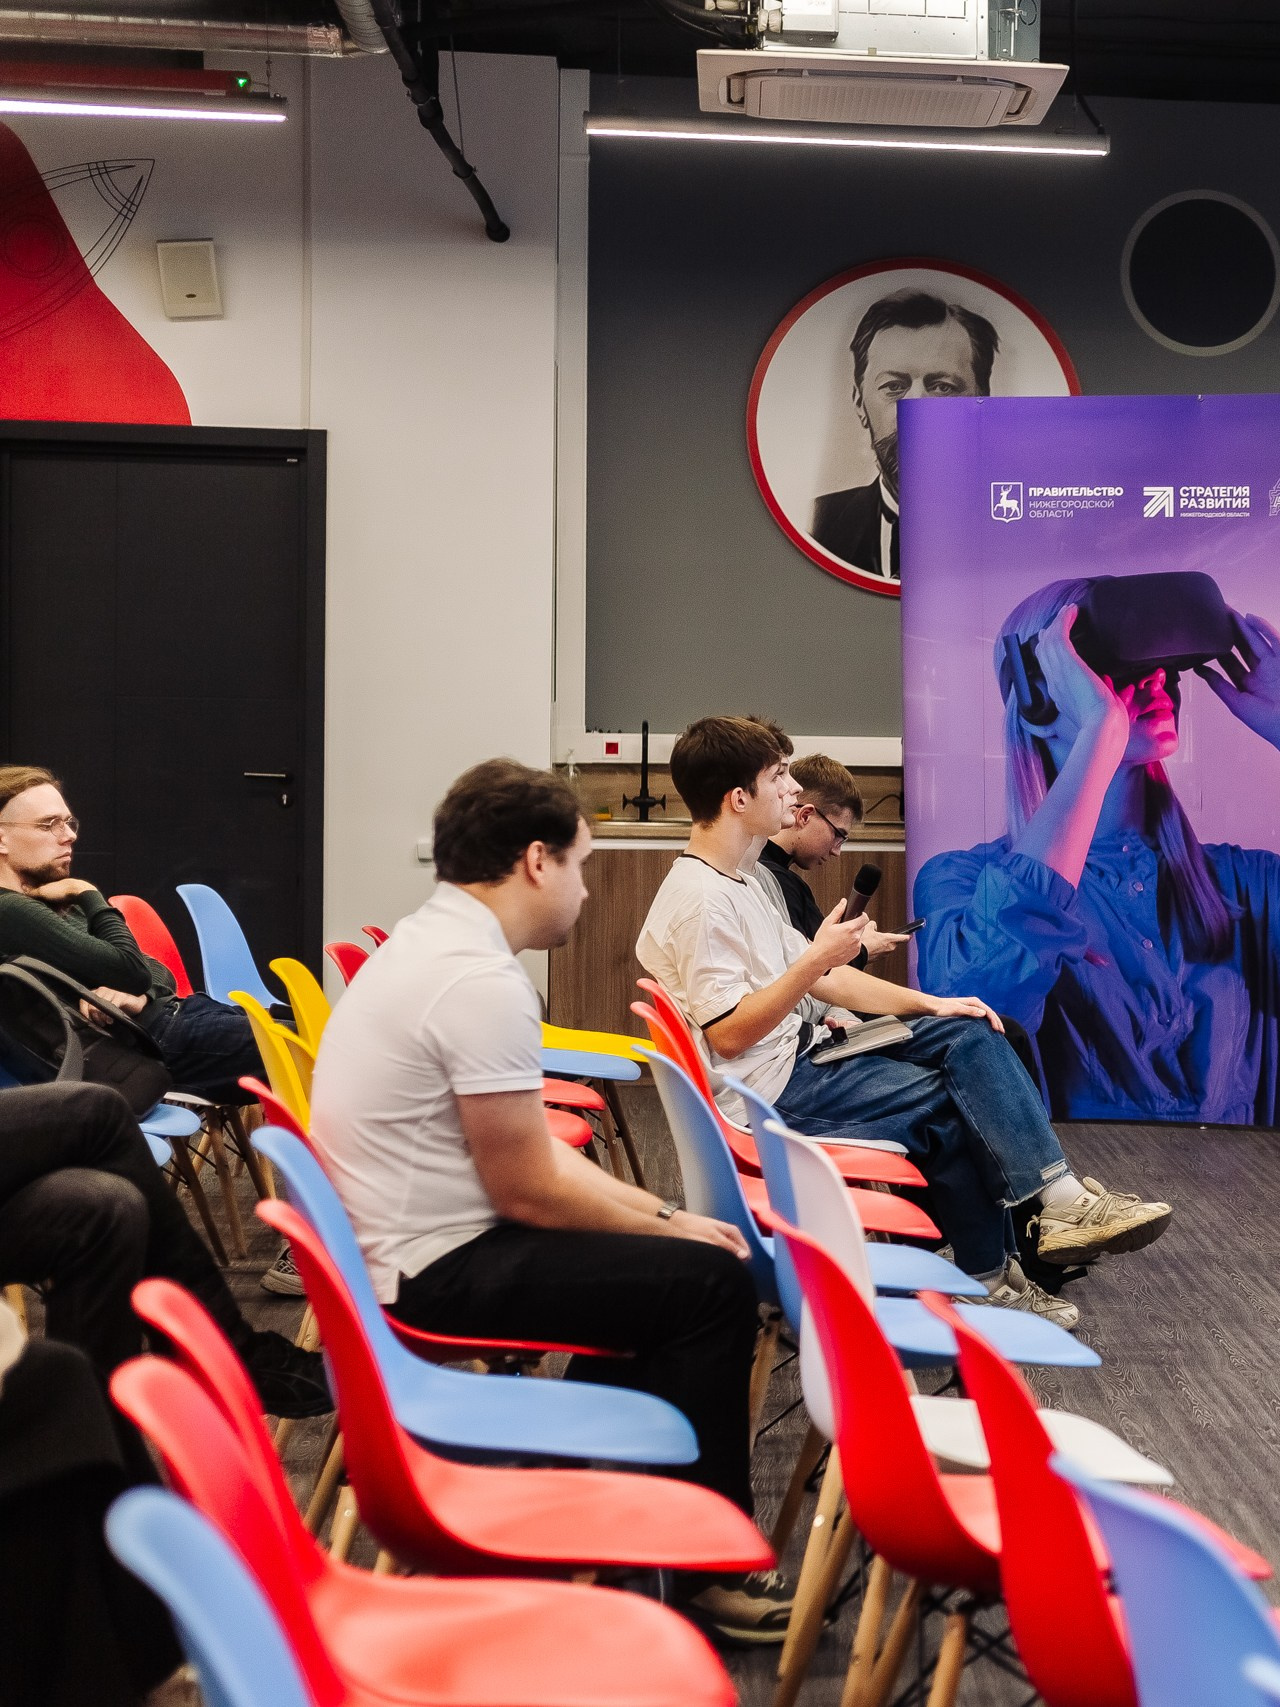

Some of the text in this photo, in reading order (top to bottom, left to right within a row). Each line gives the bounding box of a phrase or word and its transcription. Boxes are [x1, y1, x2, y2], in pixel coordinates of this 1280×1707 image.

[1028, 486, 1124, 497] ПРАВИТЕЛЬСТВО
[1179, 486, 1250, 497] СТРАТЕГИЯ
[1029, 499, 1115, 509] НИЖЕГОРОДСКОЙ
[1179, 497, 1250, 509] РАЗВИТИЯ
[1028, 510, 1074, 518] ОБЛАСТИ
